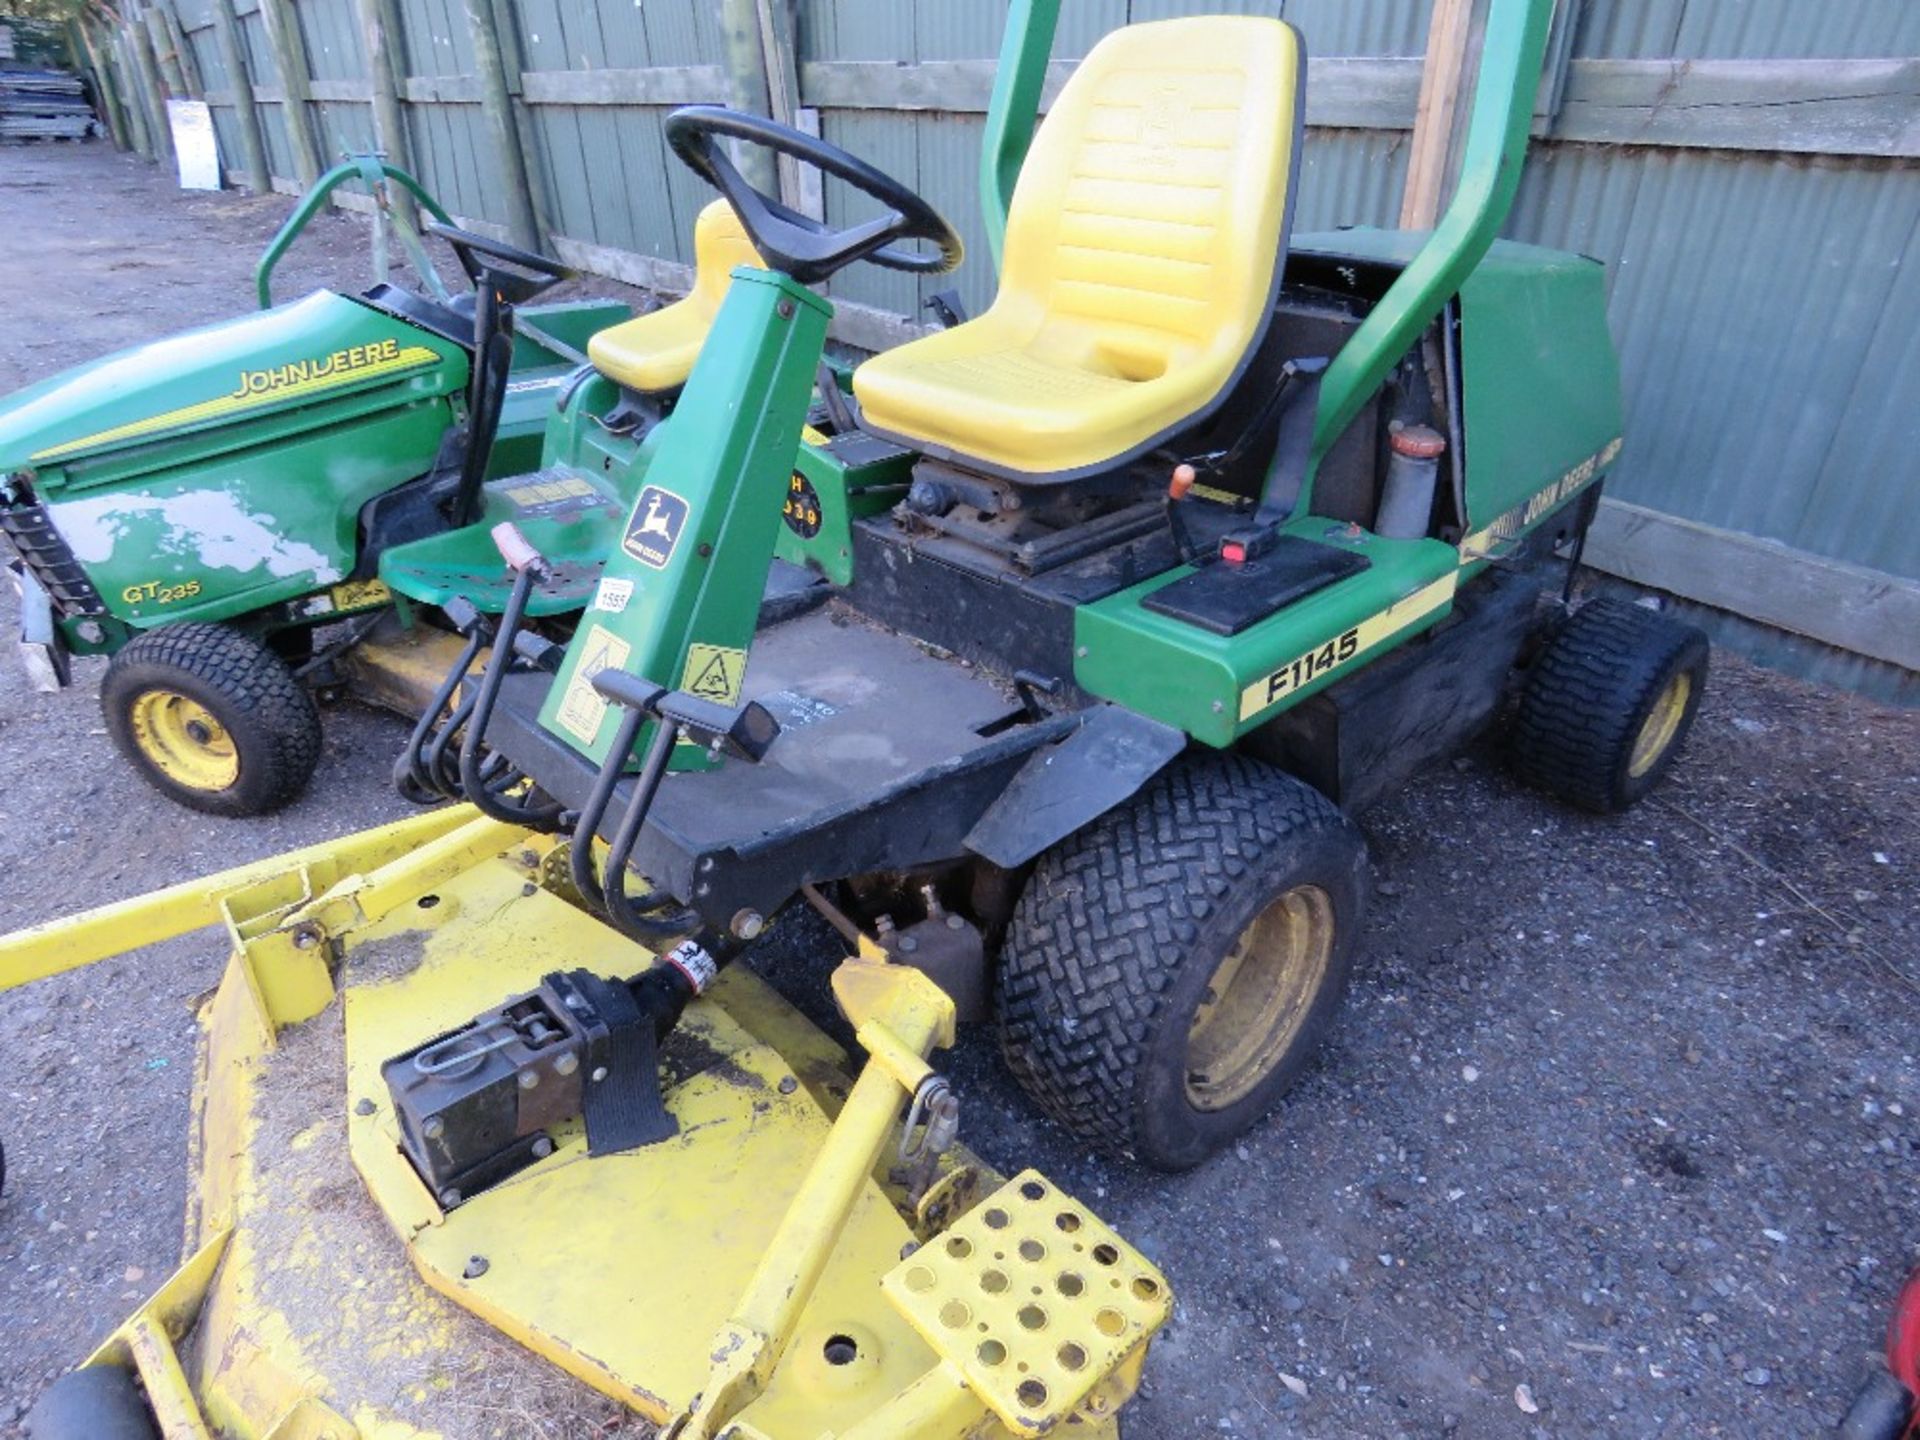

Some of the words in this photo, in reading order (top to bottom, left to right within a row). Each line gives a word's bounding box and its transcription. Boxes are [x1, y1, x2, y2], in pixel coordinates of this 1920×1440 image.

[233, 359, 310, 398] JOHN
[311, 338, 399, 379] DEERE
[1267, 628, 1358, 704] F1145
